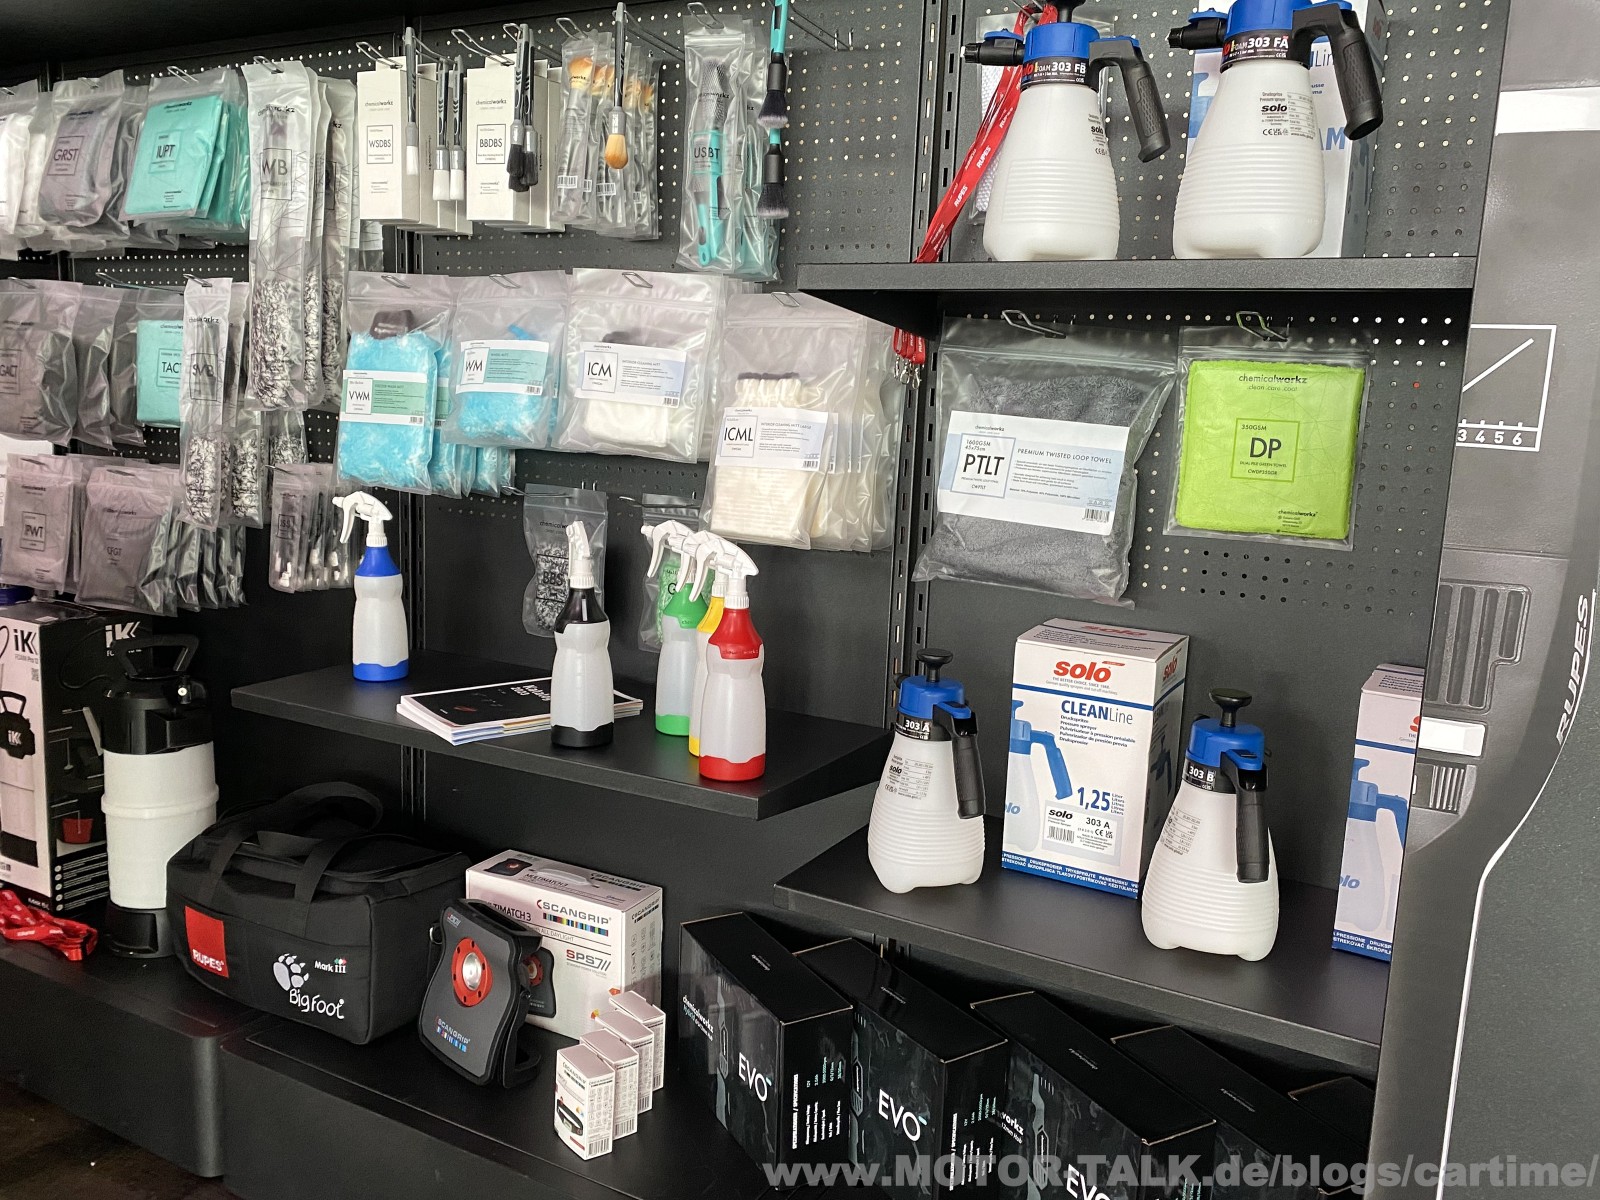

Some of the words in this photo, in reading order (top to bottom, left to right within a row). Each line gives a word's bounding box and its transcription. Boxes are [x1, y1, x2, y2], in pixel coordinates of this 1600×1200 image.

[1248, 37, 1271, 48] 303
[1274, 37, 1288, 48] FA
[1051, 62, 1071, 72] 303
[1074, 63, 1086, 73] FB
[1261, 104, 1287, 112] solo
[368, 139, 391, 148] WSDBS
[480, 138, 502, 147] BBDBS
[53, 148, 78, 162] GRST
[156, 144, 175, 158] IUPT
[693, 147, 721, 158] USBT
[976, 144, 991, 168] RUPES
[262, 159, 287, 175] WB
[954, 184, 968, 207] RUPES
[162, 362, 182, 373] TAC
[466, 360, 482, 372] WM
[587, 362, 612, 378] ICM
[1238, 374, 1308, 384] chemicalworkz
[349, 390, 370, 400] VWM
[724, 427, 753, 441] ICML
[1457, 428, 1467, 441] 3
[1475, 430, 1485, 443] 4
[1494, 431, 1504, 444] 5
[1512, 433, 1522, 445] 6
[1250, 437, 1282, 459] DP
[963, 454, 1005, 476] PTLT
[1054, 661, 1111, 682] solo
[1556, 594, 1588, 746] RUPES
[905, 720, 920, 730] 303
[922, 724, 930, 732] A
[890, 765, 902, 774] solo
[1189, 766, 1204, 779] 303
[1206, 772, 1214, 782] B
[1077, 787, 1111, 811] 1,25
[1048, 809, 1073, 820] solo
[1086, 817, 1101, 827] 303
[542, 901, 609, 925] SCANGRIP
[551, 930, 574, 942] DAYLIGHT
[1336, 932, 1366, 943] PRESSIONE
[192, 949, 222, 972] RUPES
[314, 960, 333, 972] Mark
[437, 1017, 470, 1044] SCANGRIP
[738, 1052, 768, 1102] EVO
[878, 1088, 921, 1142] EVO
